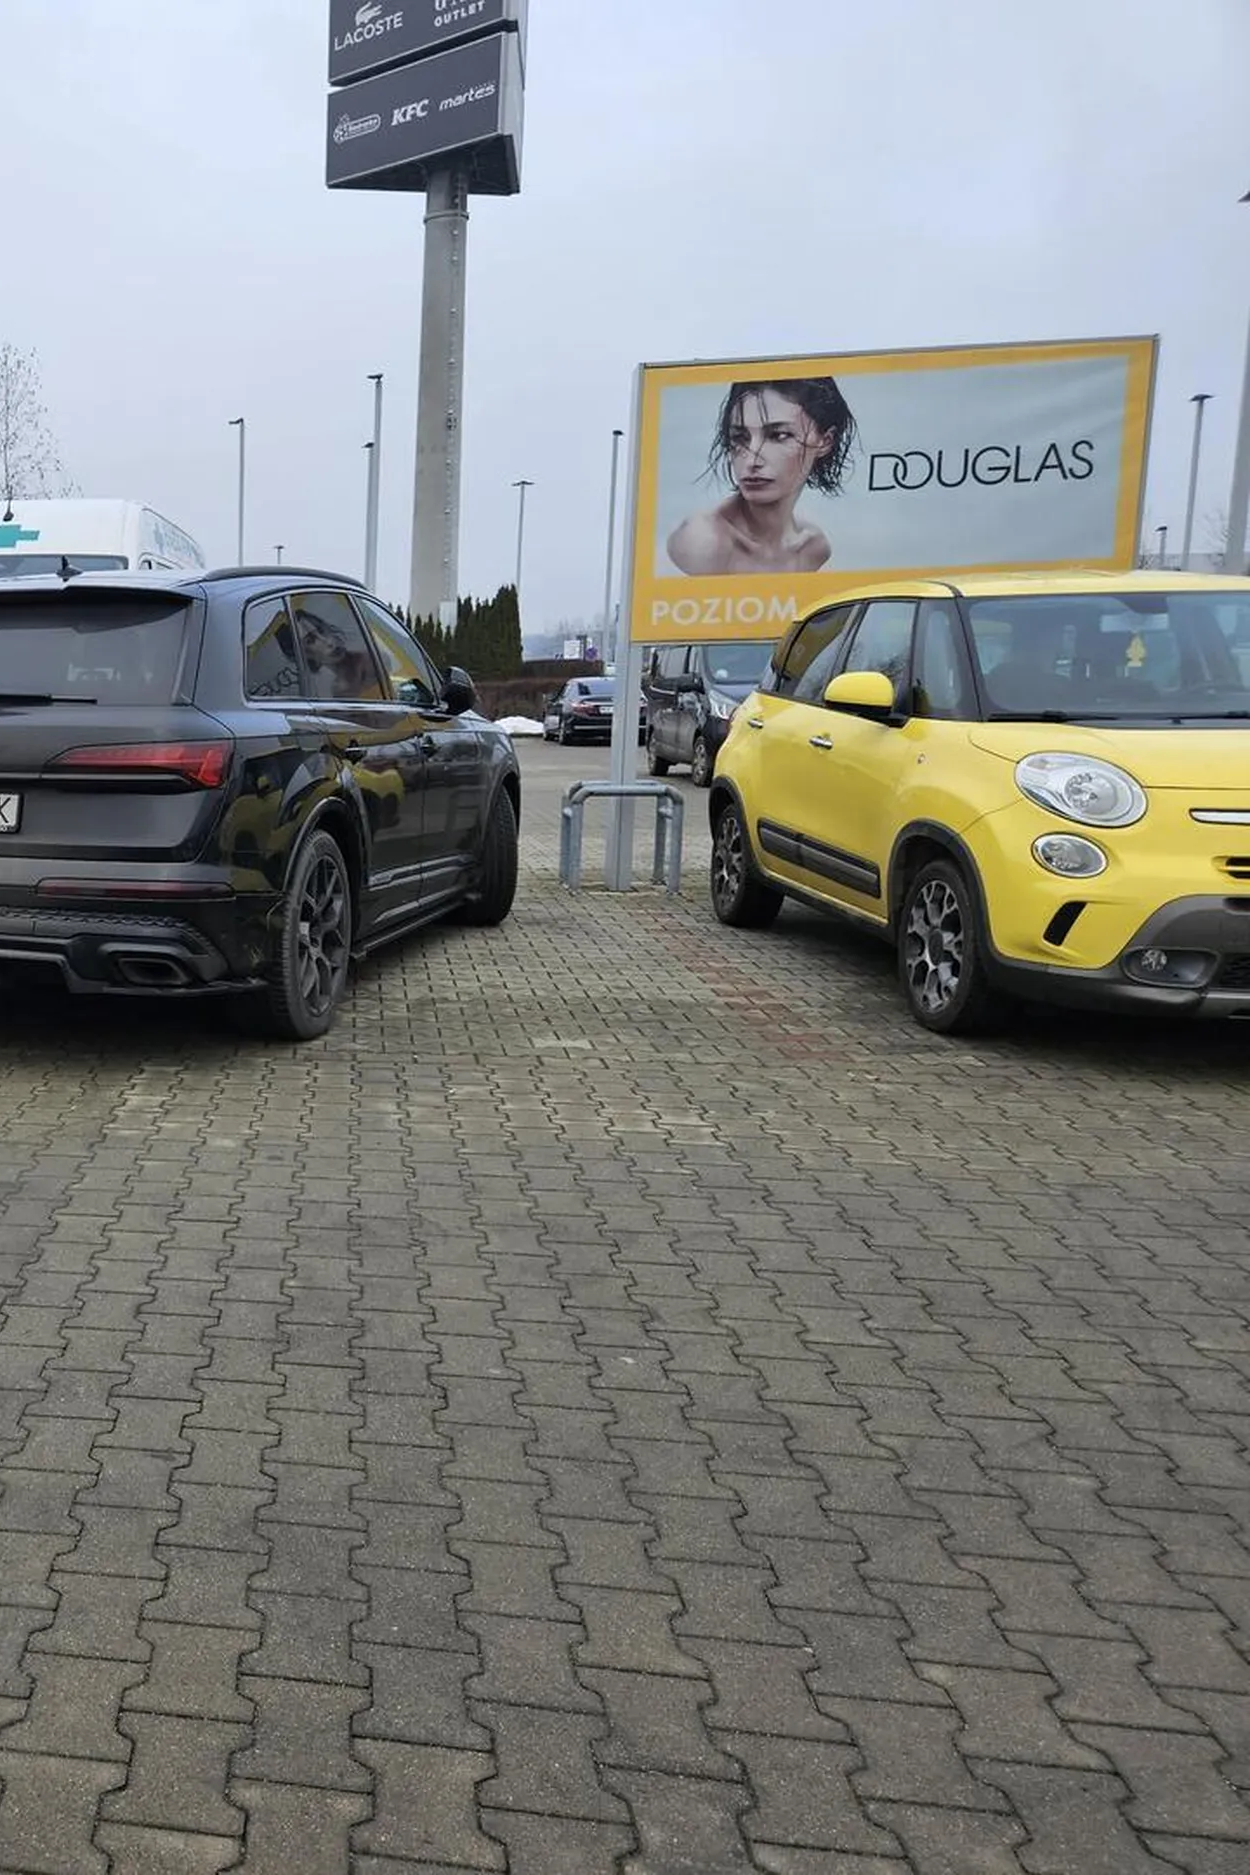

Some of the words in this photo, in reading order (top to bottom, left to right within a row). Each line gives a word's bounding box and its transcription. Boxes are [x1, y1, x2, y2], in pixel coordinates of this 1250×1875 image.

[434, 0, 485, 27] OUTLET
[334, 11, 403, 51] LACOSTE
[439, 84, 496, 111] martes
[391, 99, 429, 126] KFC
[868, 440, 1094, 491] DOUGLAS
[652, 595, 797, 626] POZIOM
